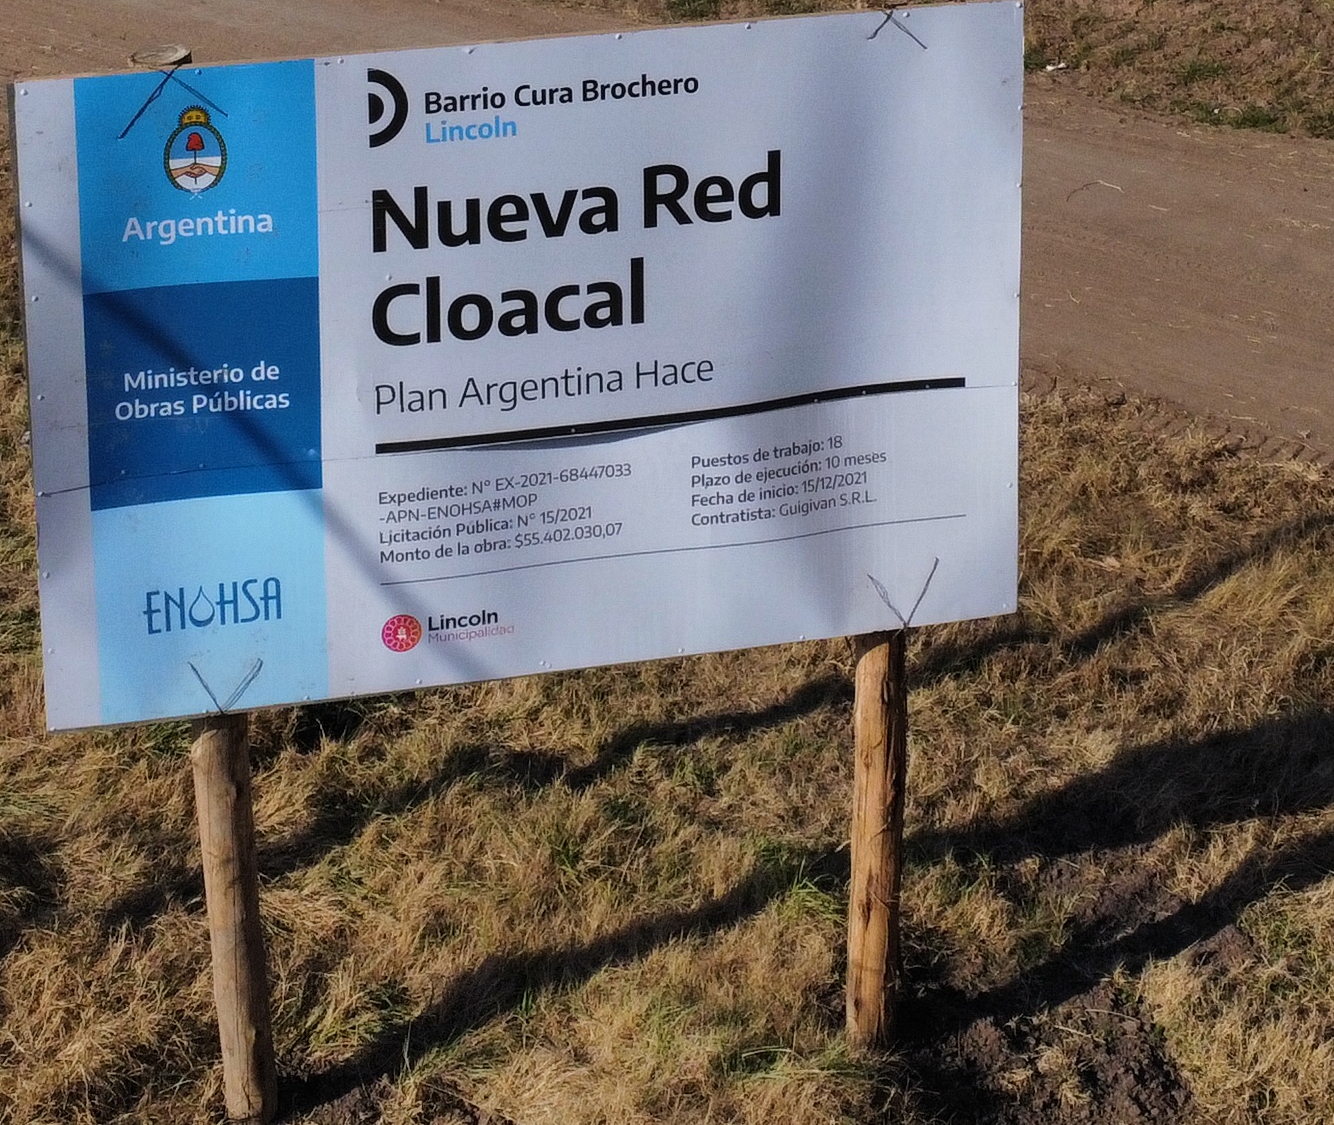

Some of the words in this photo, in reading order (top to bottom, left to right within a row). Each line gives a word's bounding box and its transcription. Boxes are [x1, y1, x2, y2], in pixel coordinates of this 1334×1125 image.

[425, 87, 506, 115] Barrio
[514, 85, 573, 107] Cura
[582, 74, 699, 102] Brochero
[425, 115, 517, 143] Lincoln
[372, 186, 619, 253] Nueva
[643, 149, 781, 229] Red
[122, 208, 274, 245] Argentina
[372, 257, 645, 346] Cloacal
[123, 363, 244, 392] Ministerio
[251, 360, 280, 381] de
[375, 381, 447, 415] Plan
[459, 366, 623, 411] Argentina
[636, 359, 714, 389] Hace
[115, 398, 185, 421] Obras
[192, 389, 291, 414] Públicas
[692, 452, 749, 469] Puestos
[753, 448, 769, 463] de
[773, 439, 825, 460] trabajo:
[828, 435, 843, 449] 18
[692, 473, 731, 489] Plazo
[735, 470, 752, 484] de
[756, 459, 822, 483] ejecución:
[825, 456, 840, 470] 10
[844, 451, 887, 467] meses
[379, 485, 467, 506] Expediente:
[471, 480, 491, 495] N°
[495, 463, 632, 492] EX-2021-68447033
[692, 493, 734, 507] Fecha
[738, 488, 755, 503] de
[759, 484, 799, 500] inicio:
[801, 471, 868, 493] 15/12/2021
[379, 493, 538, 524] -APN-ENOHSA#MOP
[456, 518, 513, 537] Pública:
[517, 513, 536, 528] N°
[540, 505, 593, 525] 15/2021
[692, 508, 775, 526] Contratista:
[779, 497, 836, 517] Guigivan
[840, 490, 877, 507] S.R.L.
[380, 549, 431, 564] Monto
[435, 544, 453, 559] de
[457, 542, 469, 556] la
[474, 538, 511, 554] obra:
[515, 522, 623, 549] $55.402.030,07
[142, 577, 282, 635] ENOHSA
[428, 610, 499, 631] Lincoln
[428, 625, 515, 643] Municipalidad
